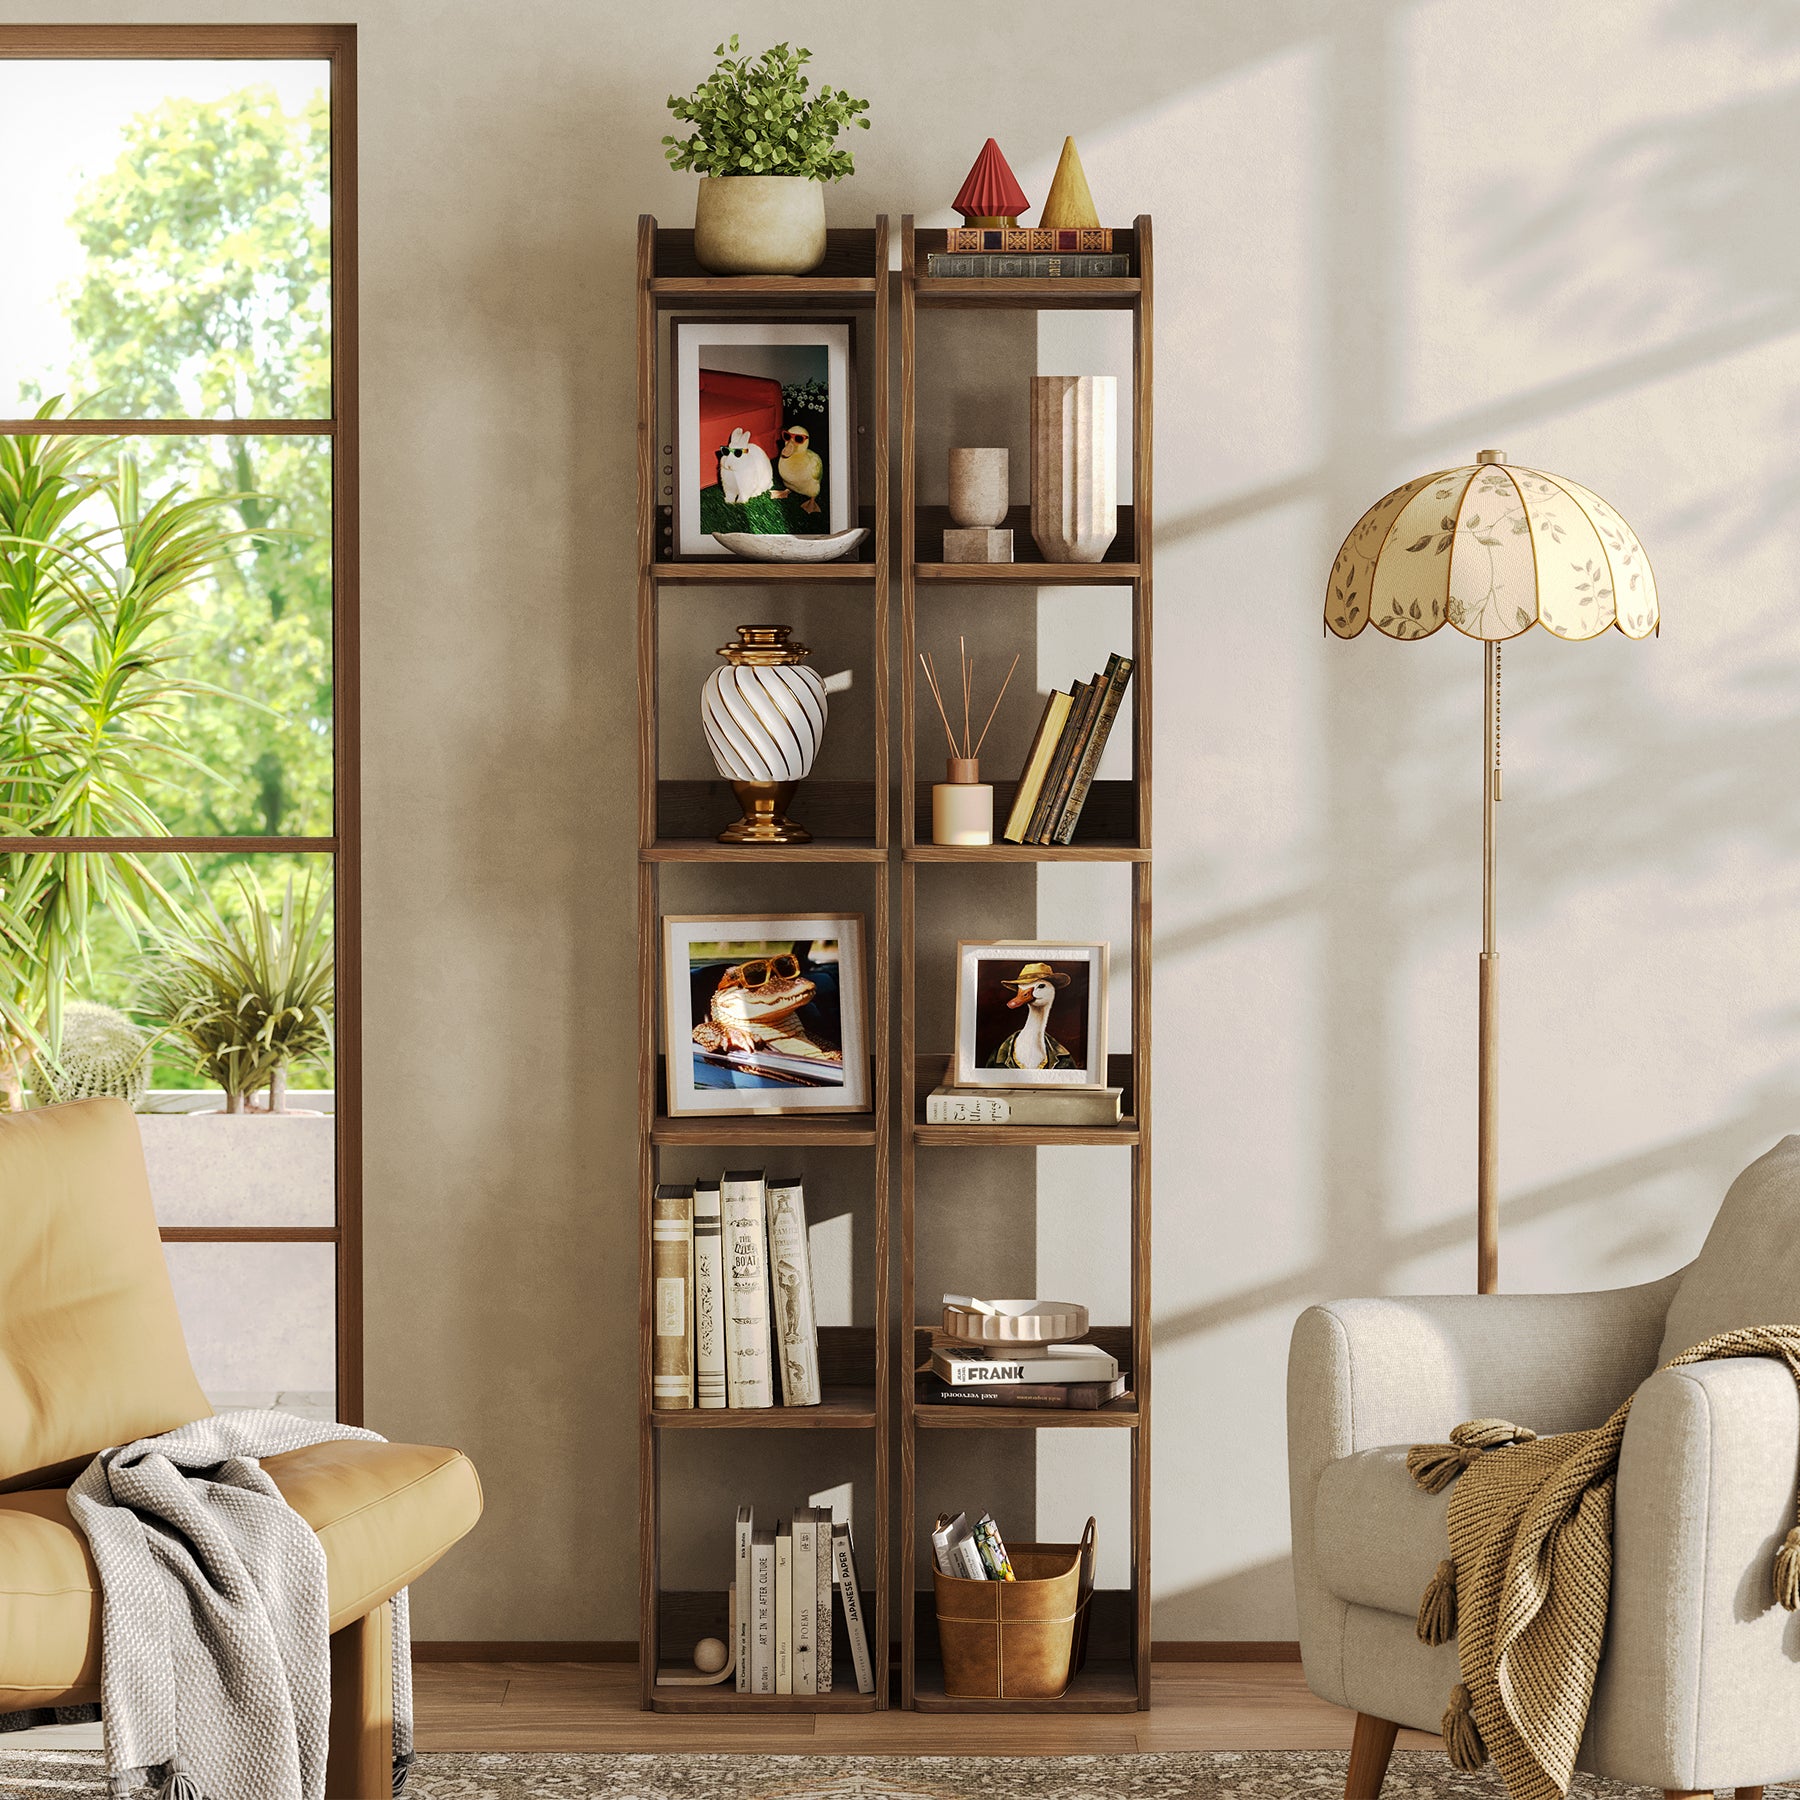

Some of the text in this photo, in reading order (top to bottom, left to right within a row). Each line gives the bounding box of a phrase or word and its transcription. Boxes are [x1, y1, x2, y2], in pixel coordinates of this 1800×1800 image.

[739, 1235, 751, 1243] THE
[735, 1255, 756, 1267] BOAT
[968, 1366, 1024, 1380] FRANK
[940, 1391, 980, 1399] vervoordt
[839, 1551, 859, 1622] JAPANESE PAPER
[759, 1557, 768, 1646] ART IN THE AFTER CULTURE
[800, 1608, 809, 1640] POEMS
[761, 1666, 769, 1681] Davis
